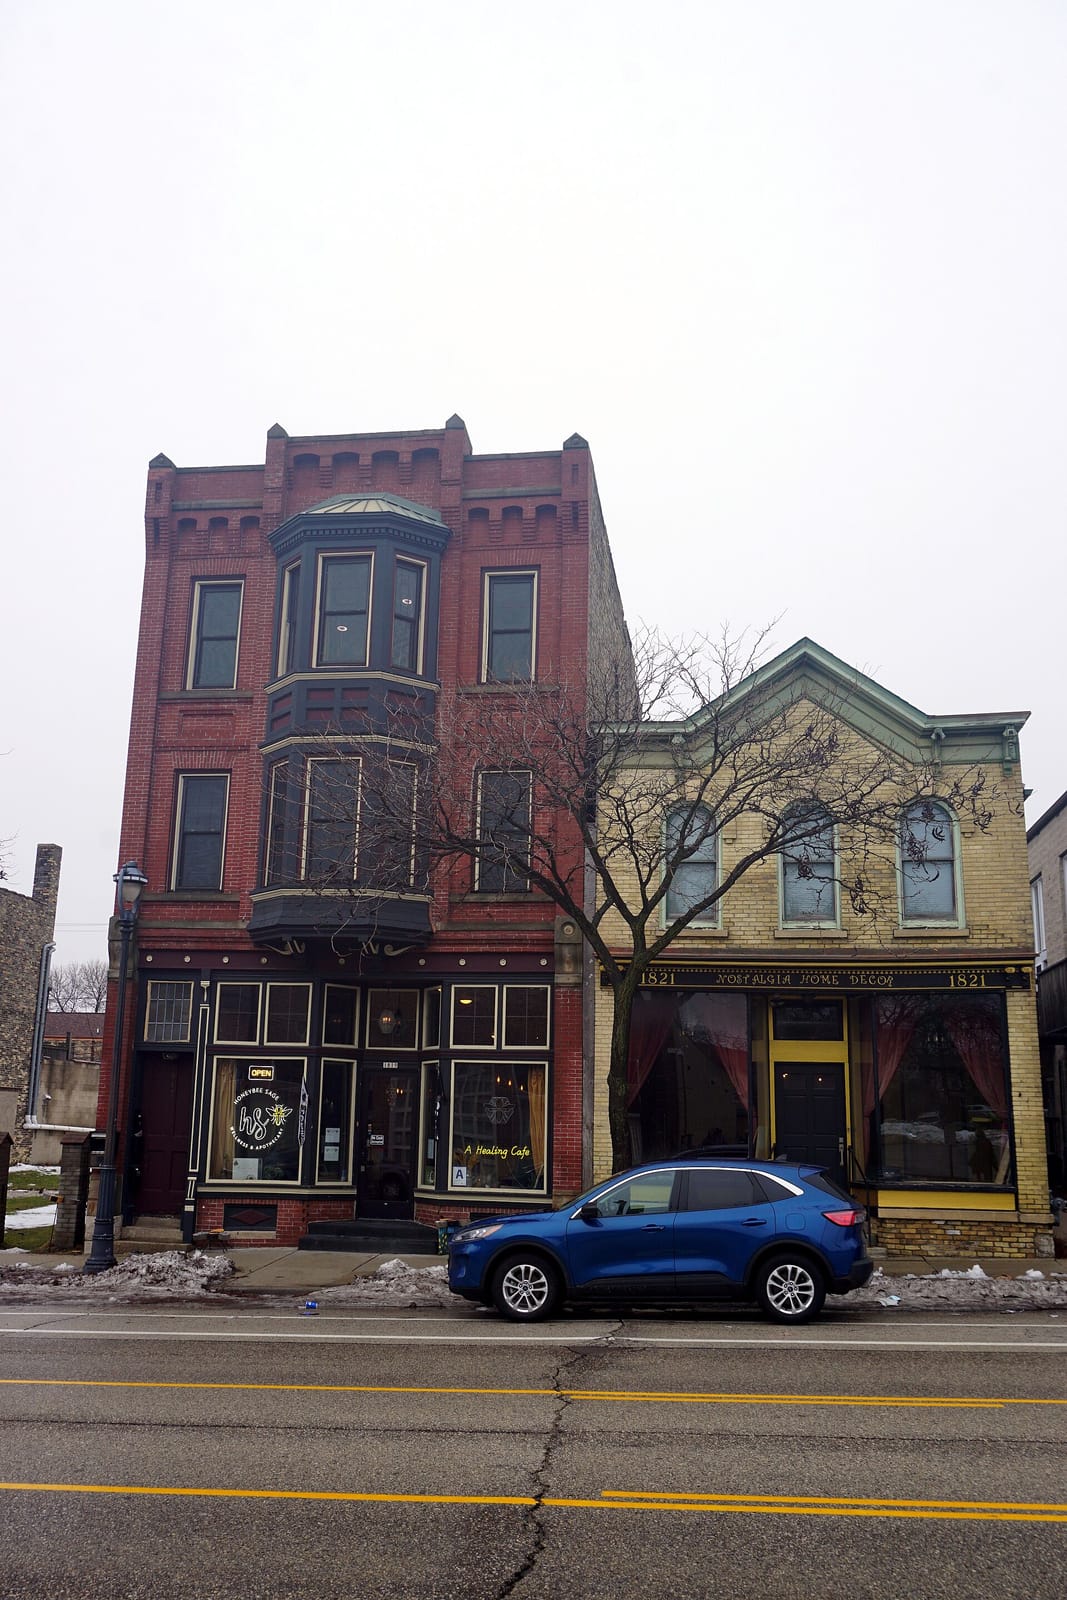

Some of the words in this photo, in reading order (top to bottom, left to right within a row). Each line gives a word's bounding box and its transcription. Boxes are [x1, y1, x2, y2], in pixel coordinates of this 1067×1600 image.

[641, 972, 675, 985] 1821
[716, 974, 792, 985] NOSTALGIA
[800, 974, 839, 985] HOME
[850, 974, 894, 987] DECOR
[950, 973, 985, 987] 1821
[251, 1069, 272, 1077] OPEN
[233, 1087, 264, 1105] HONEYBEE
[265, 1088, 280, 1102] SAGE
[464, 1145, 472, 1155] A
[476, 1145, 508, 1160] Healing
[511, 1145, 530, 1160] Cafe
[455, 1169, 464, 1180] A
